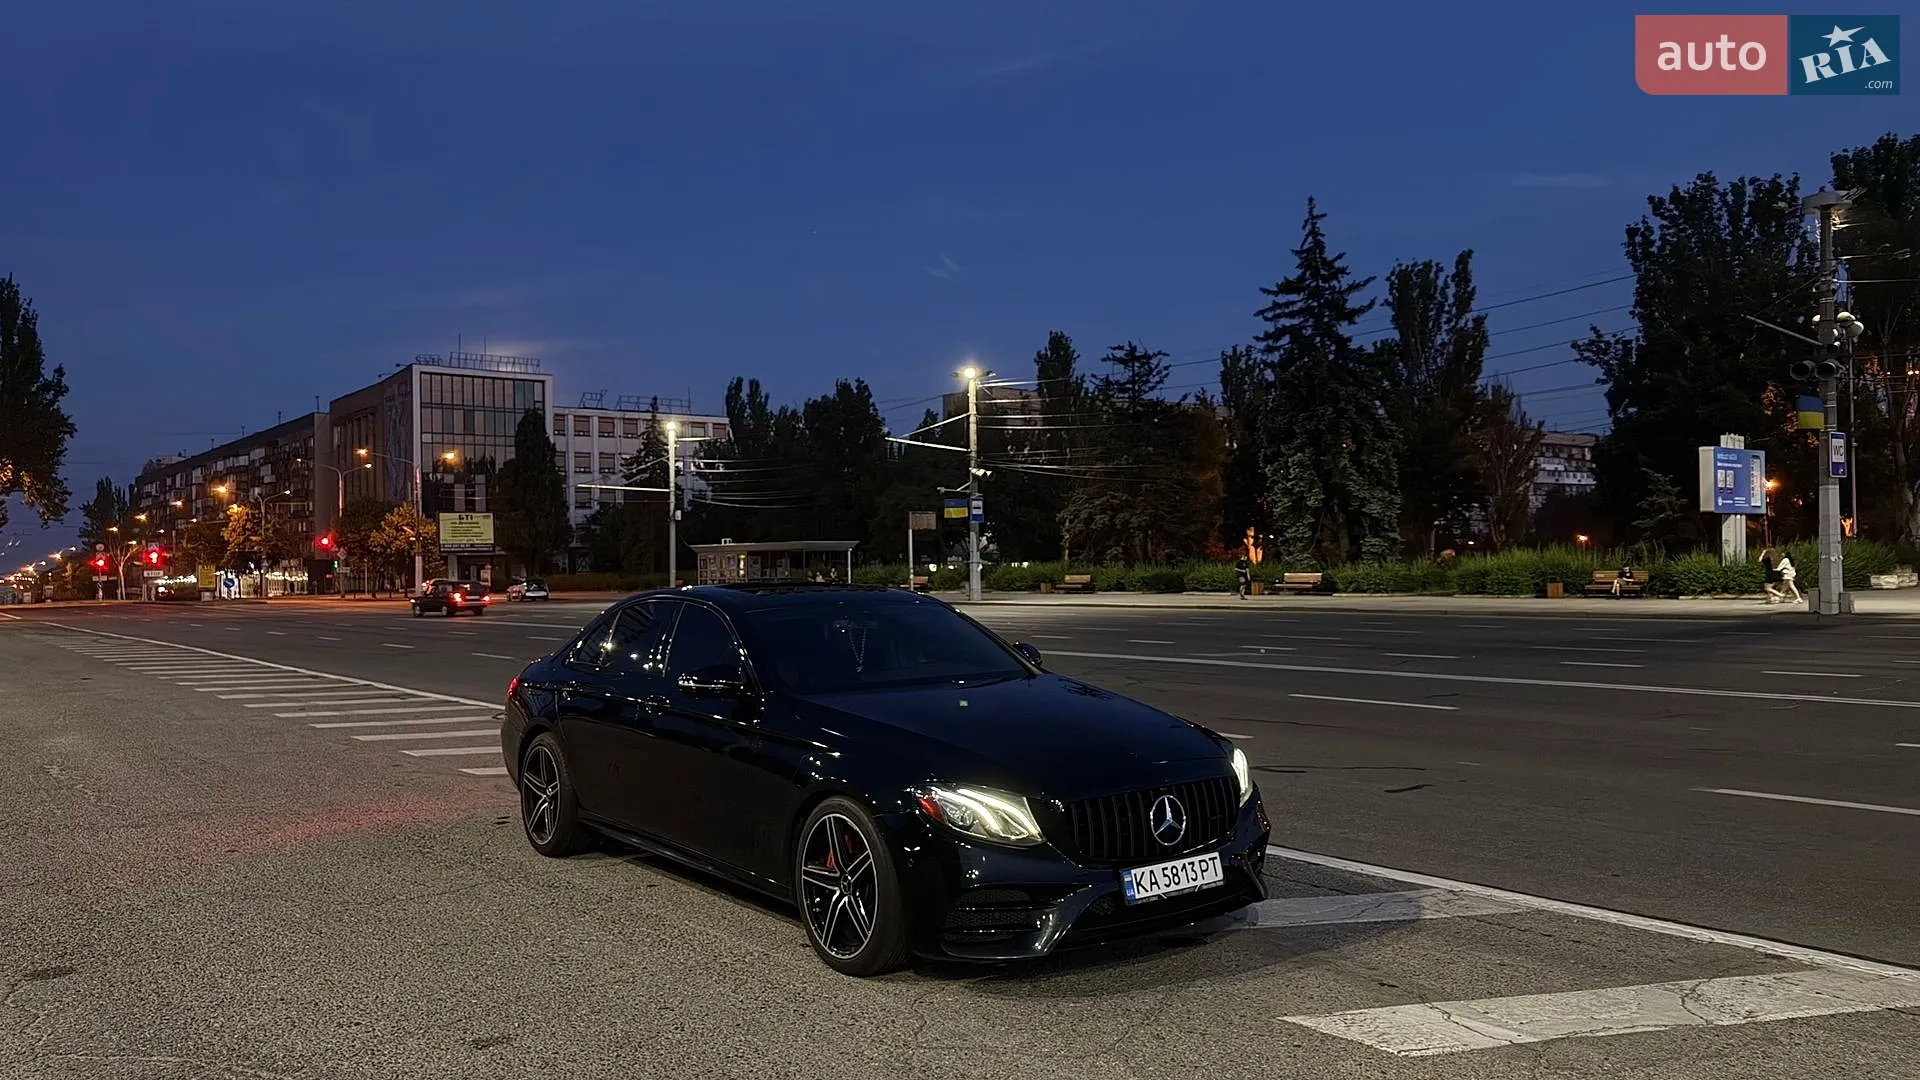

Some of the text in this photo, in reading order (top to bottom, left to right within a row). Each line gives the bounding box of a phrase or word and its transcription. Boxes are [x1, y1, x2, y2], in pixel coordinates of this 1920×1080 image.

[1832, 445, 1844, 457] WC
[1134, 869, 1161, 894] KA
[1162, 861, 1198, 888] 5813
[1198, 856, 1218, 880] PT
[1126, 888, 1135, 897] UA
